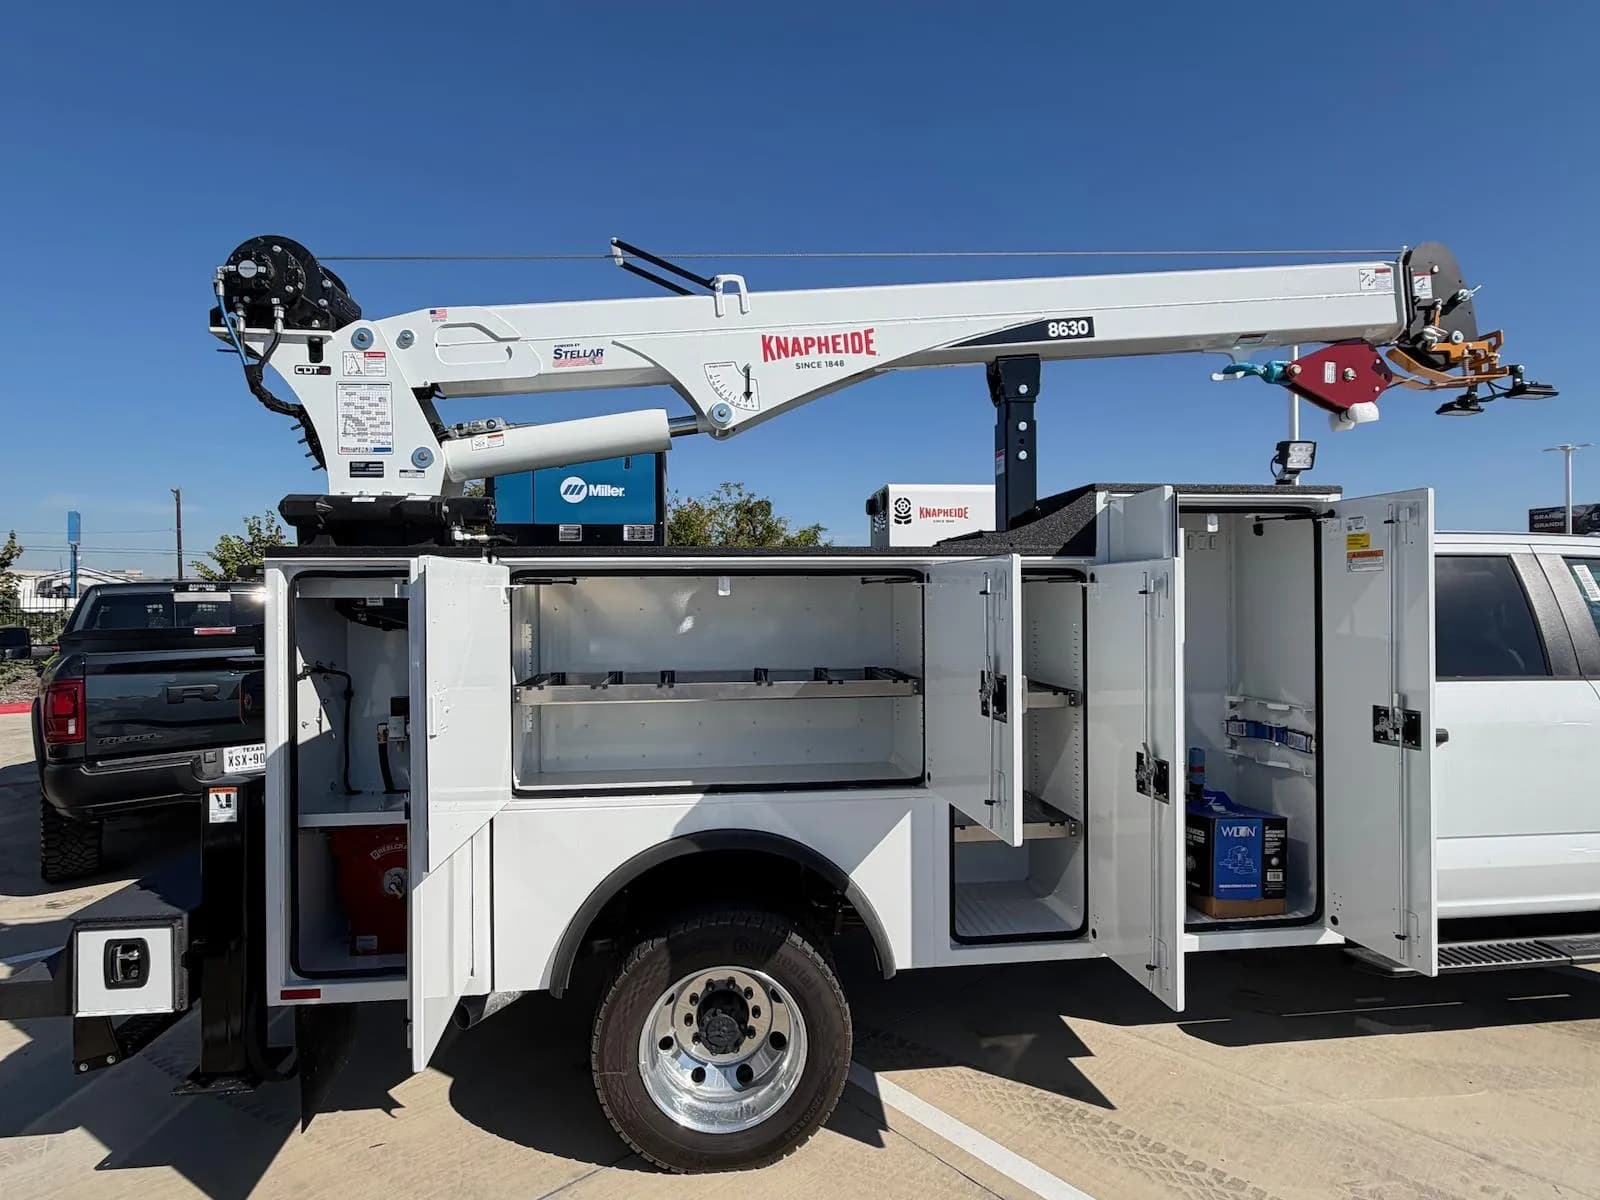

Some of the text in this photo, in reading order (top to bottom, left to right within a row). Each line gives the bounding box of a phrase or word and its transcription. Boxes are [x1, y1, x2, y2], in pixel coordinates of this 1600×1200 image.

[1048, 320, 1089, 337] 8630
[761, 328, 877, 362] KNAPHEIDE
[553, 348, 604, 359] STELLAR
[295, 366, 320, 375] CDT
[795, 361, 823, 370] SINCE
[589, 484, 624, 496] Miller
[919, 506, 969, 519] KNAPHEIDE
